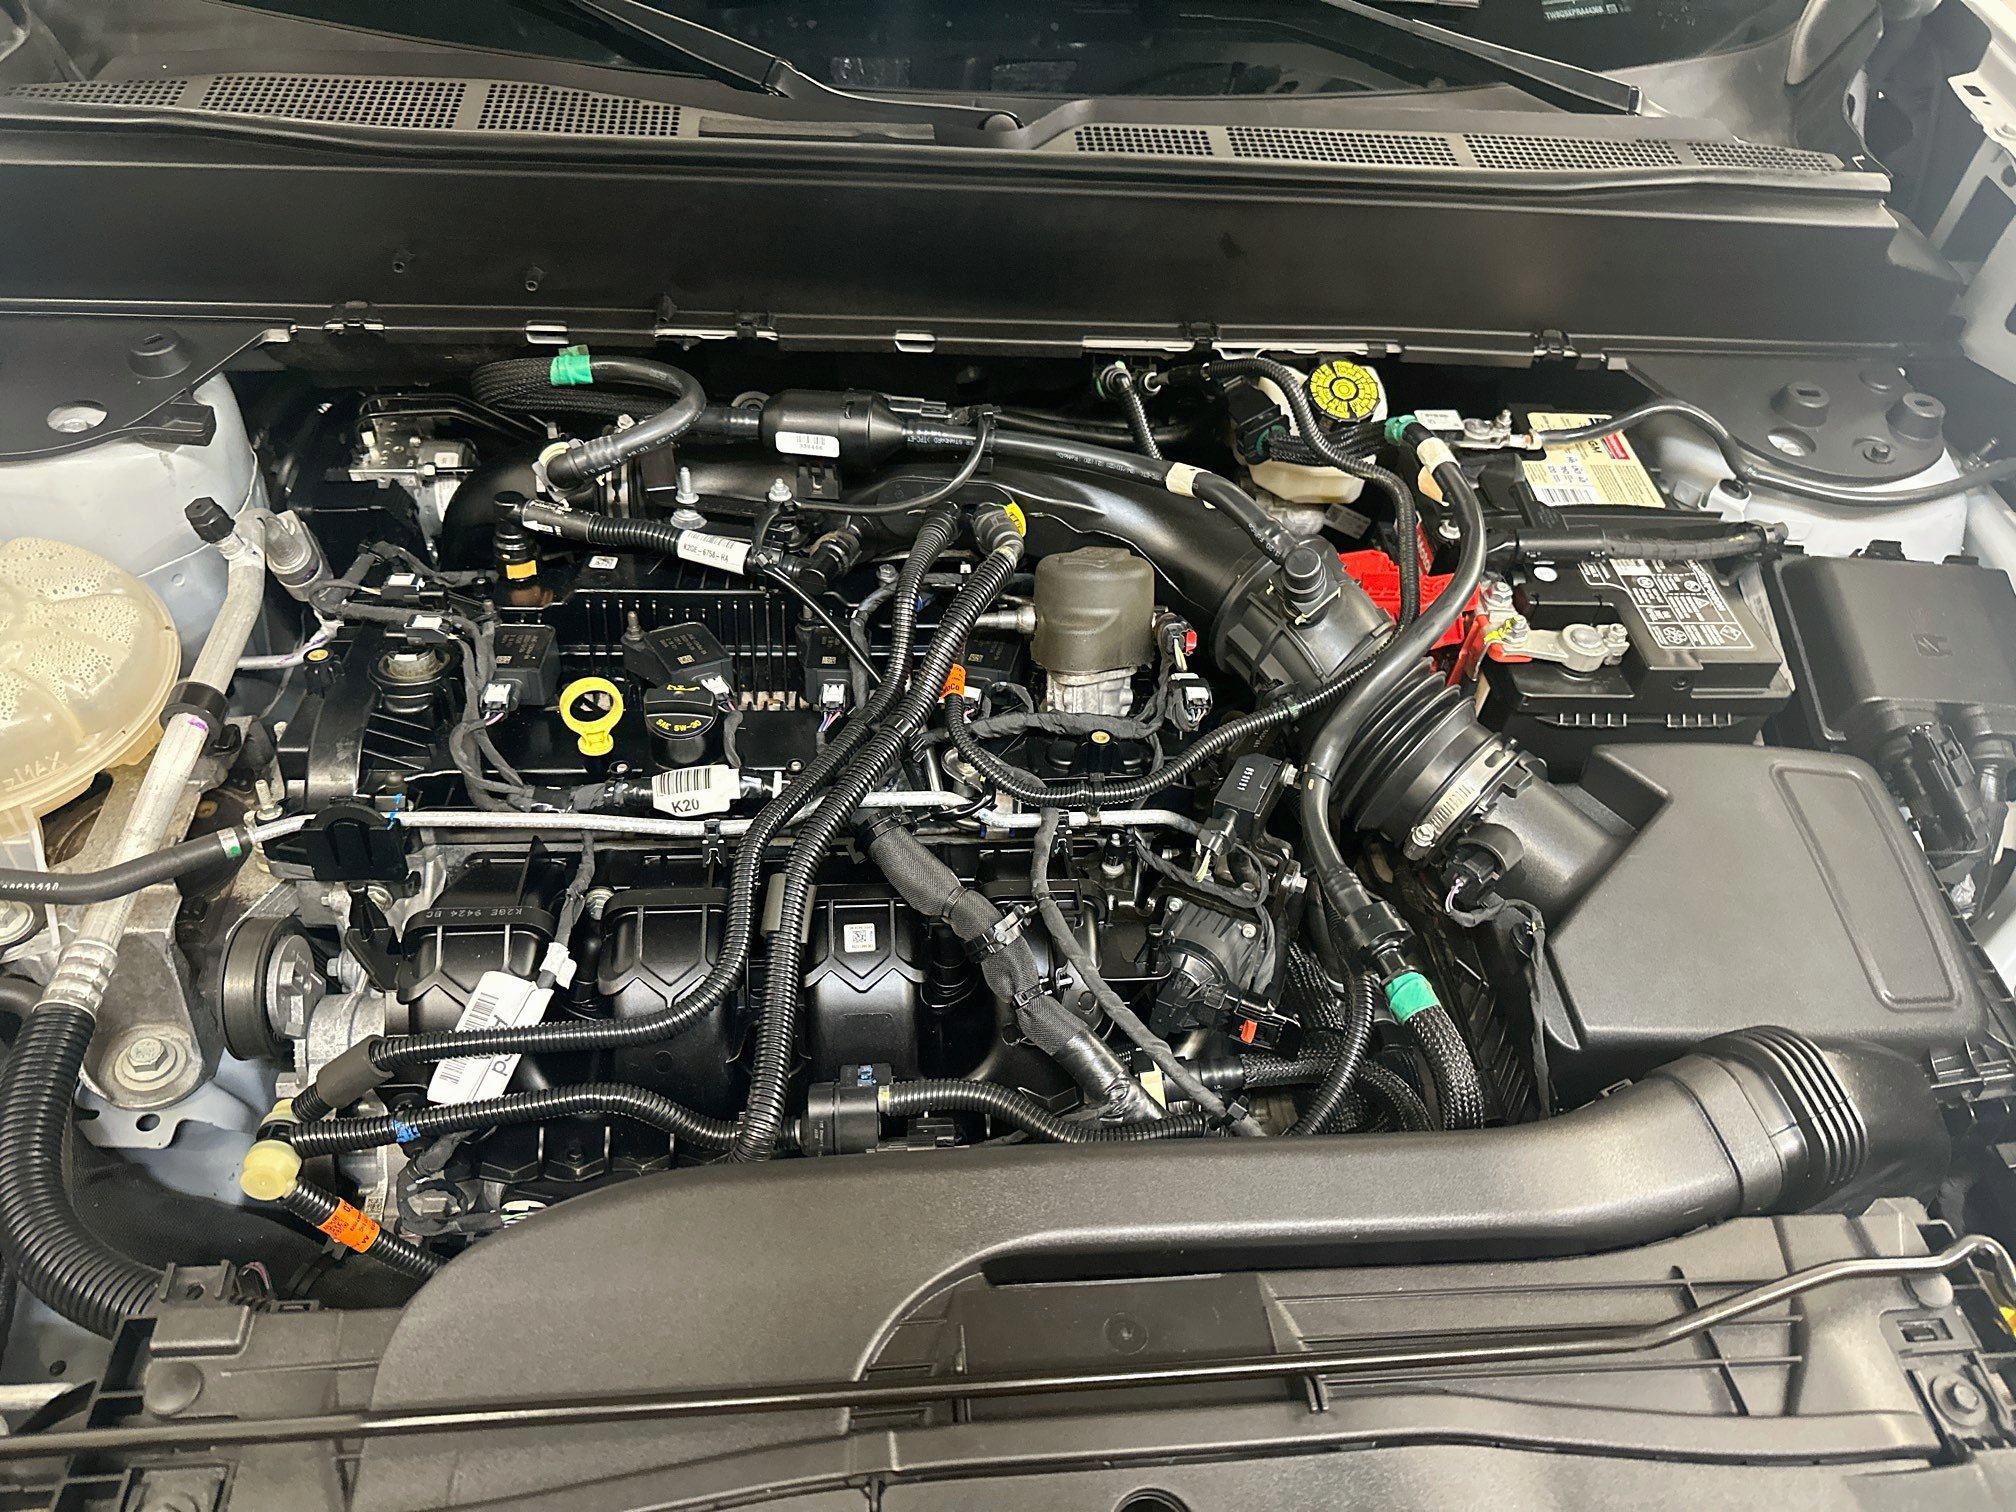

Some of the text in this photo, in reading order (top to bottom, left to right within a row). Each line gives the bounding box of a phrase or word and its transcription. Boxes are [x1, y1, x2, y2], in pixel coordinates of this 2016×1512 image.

[655, 718, 702, 732] SAE 5W-30
[671, 798, 700, 814] K20
[450, 908, 481, 918] 9424
